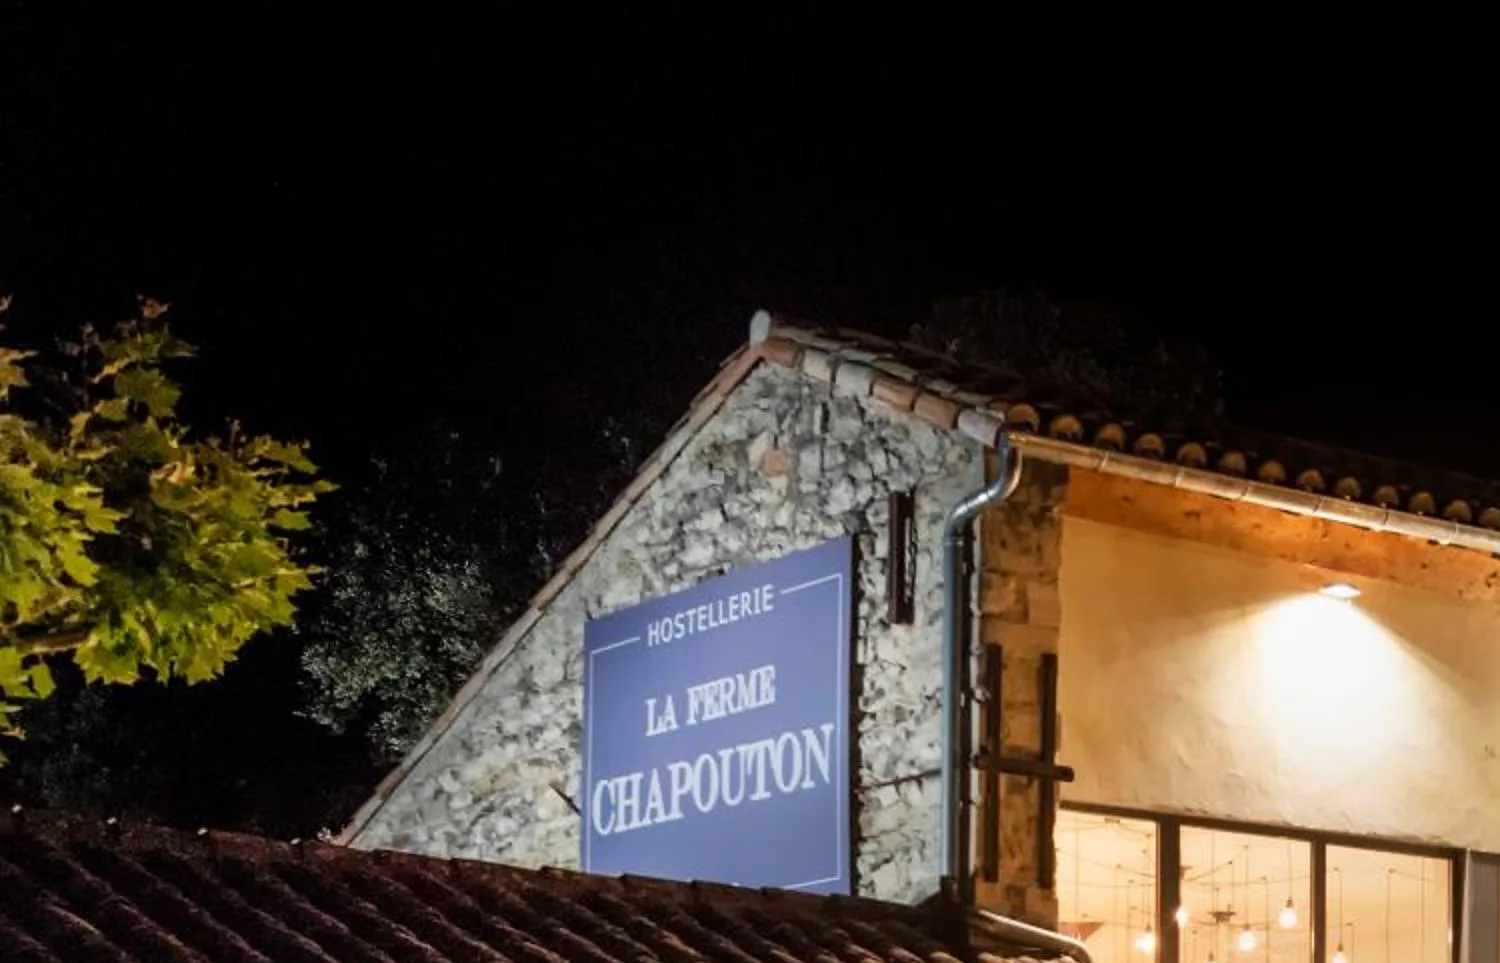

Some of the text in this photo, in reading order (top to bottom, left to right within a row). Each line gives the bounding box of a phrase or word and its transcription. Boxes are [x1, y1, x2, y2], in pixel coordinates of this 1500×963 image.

[647, 584, 775, 647] HOSTELLERIE
[645, 664, 777, 737] LA FERME
[592, 723, 835, 836] CHAPOUTON
